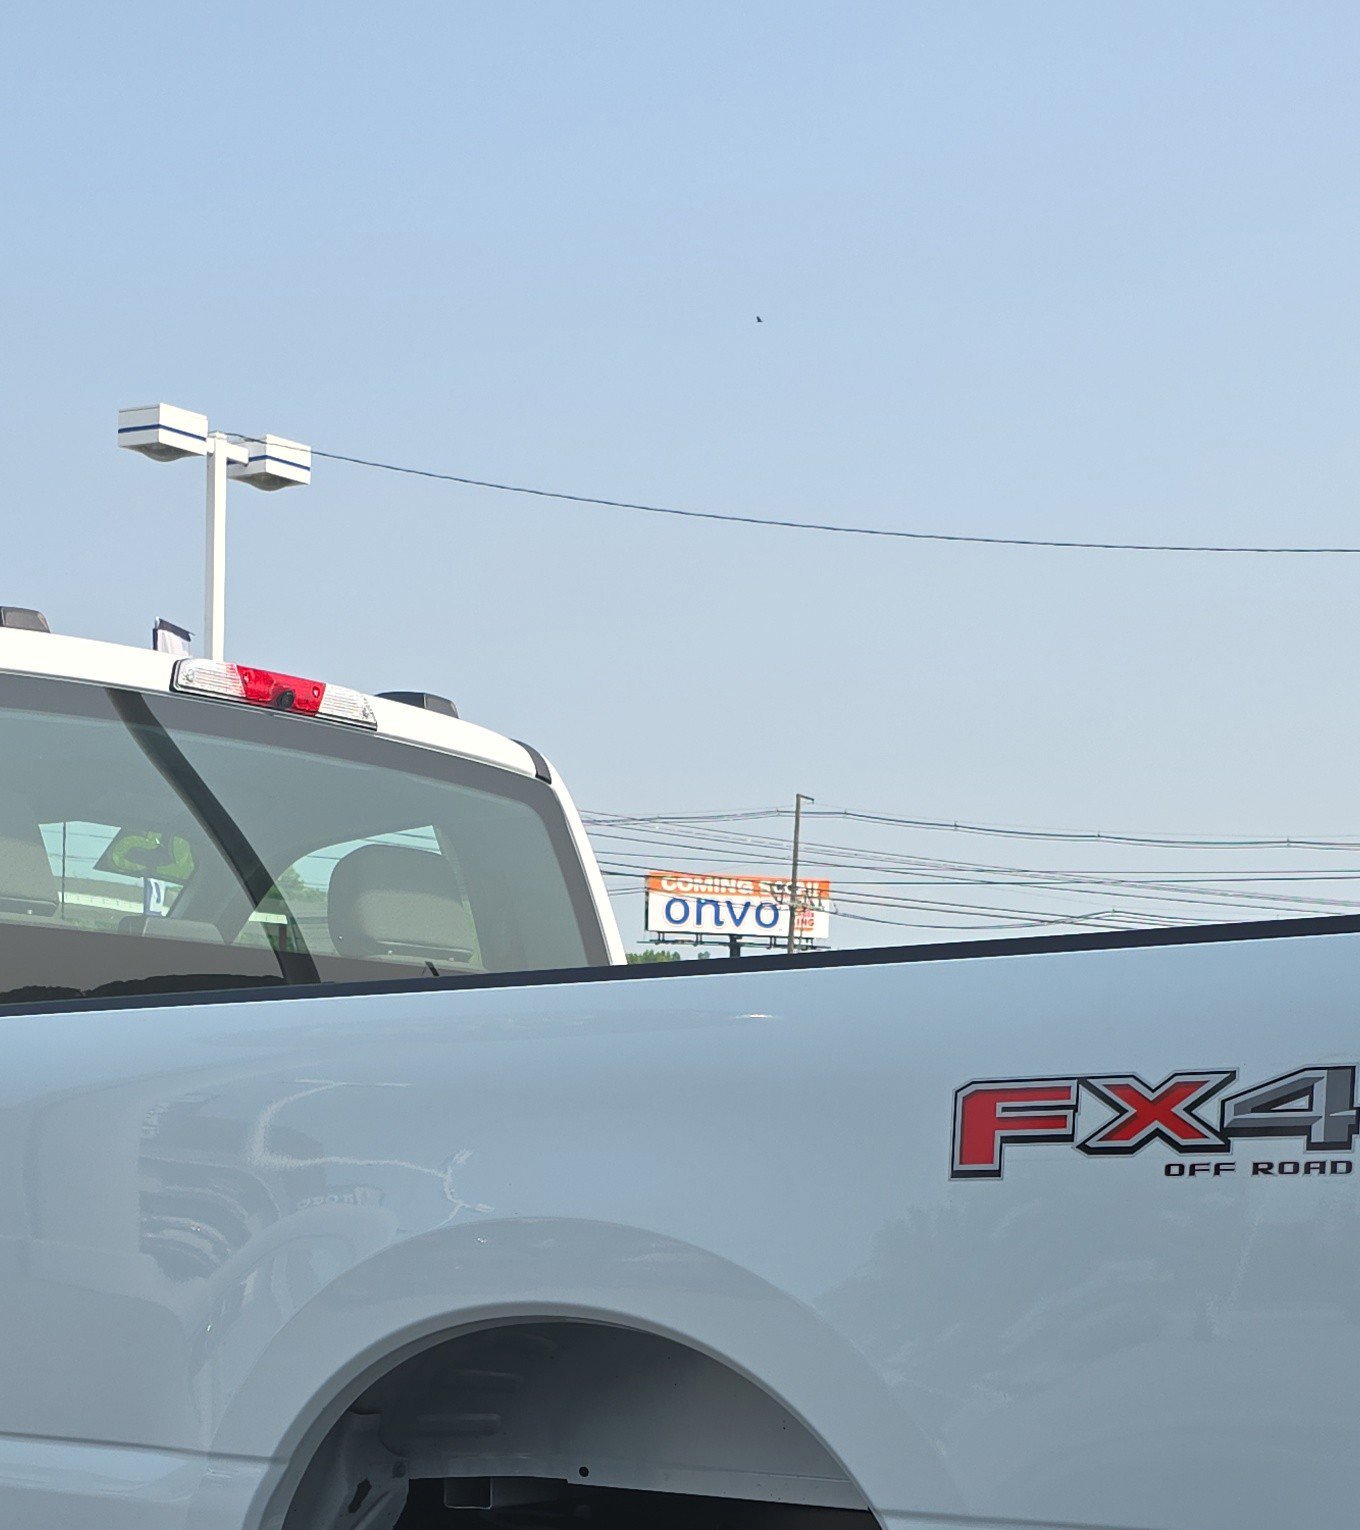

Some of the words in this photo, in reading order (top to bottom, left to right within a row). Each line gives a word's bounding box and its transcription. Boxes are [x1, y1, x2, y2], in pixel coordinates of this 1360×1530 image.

[661, 877, 754, 896] COMING
[665, 897, 779, 928] onvo
[1163, 1161, 1237, 1178] OFF
[1251, 1159, 1354, 1177] ROAD
